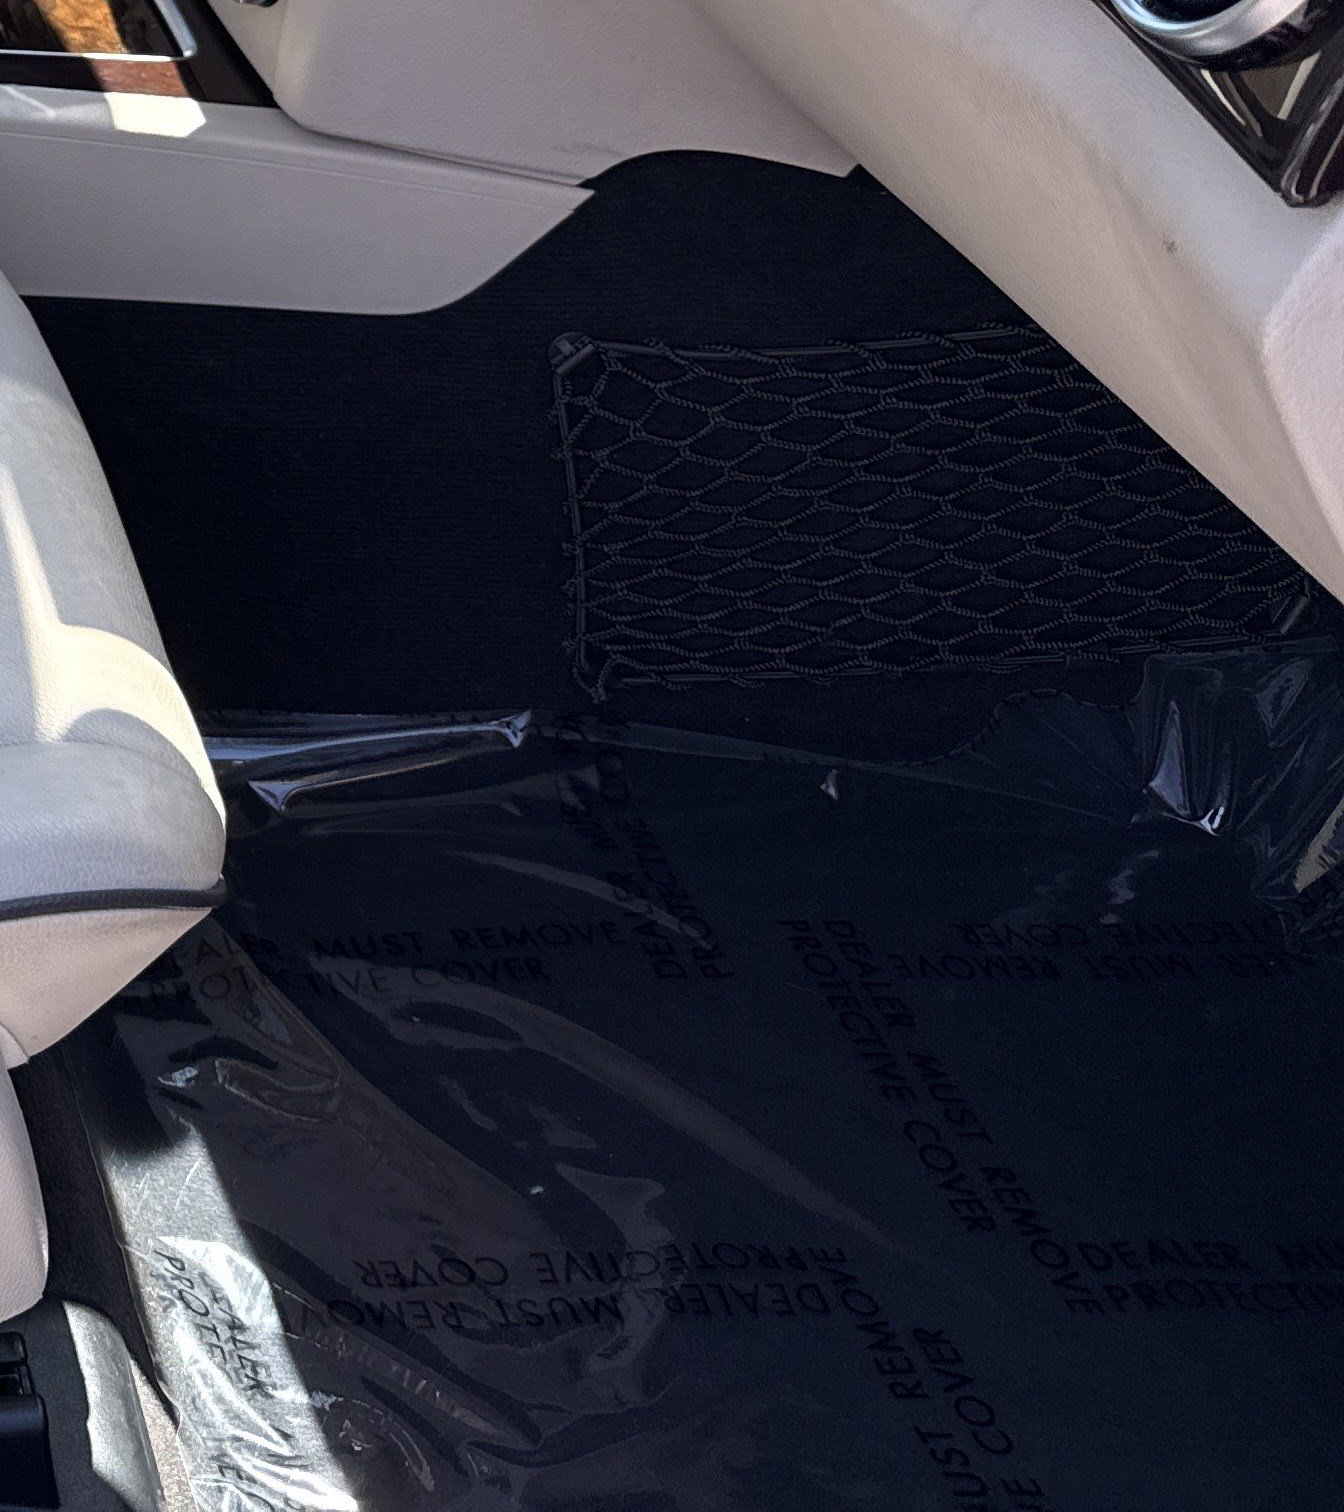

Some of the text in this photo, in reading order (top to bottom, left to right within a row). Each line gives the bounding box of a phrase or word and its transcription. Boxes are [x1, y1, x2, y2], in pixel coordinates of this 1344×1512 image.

[313, 928, 424, 960] MUST
[449, 920, 627, 954] REMOVE
[412, 954, 552, 989] COVER
[885, 953, 1064, 983] REMOVE
[1082, 954, 1198, 983] MUST
[776, 918, 997, 1234] PROTECTIVE COVER
[821, 918, 1108, 1316] DEALER MUST REMOVE
[352, 1240, 810, 1290] PROTECTIVE COVER
[1076, 1236, 1253, 1273] DEALER
[496, 1292, 623, 1329] MUST
[662, 1278, 831, 1318] DEALER
[812, 1245, 989, 1512] UST REMOVE
[913, 1326, 1014, 1456] COVER
